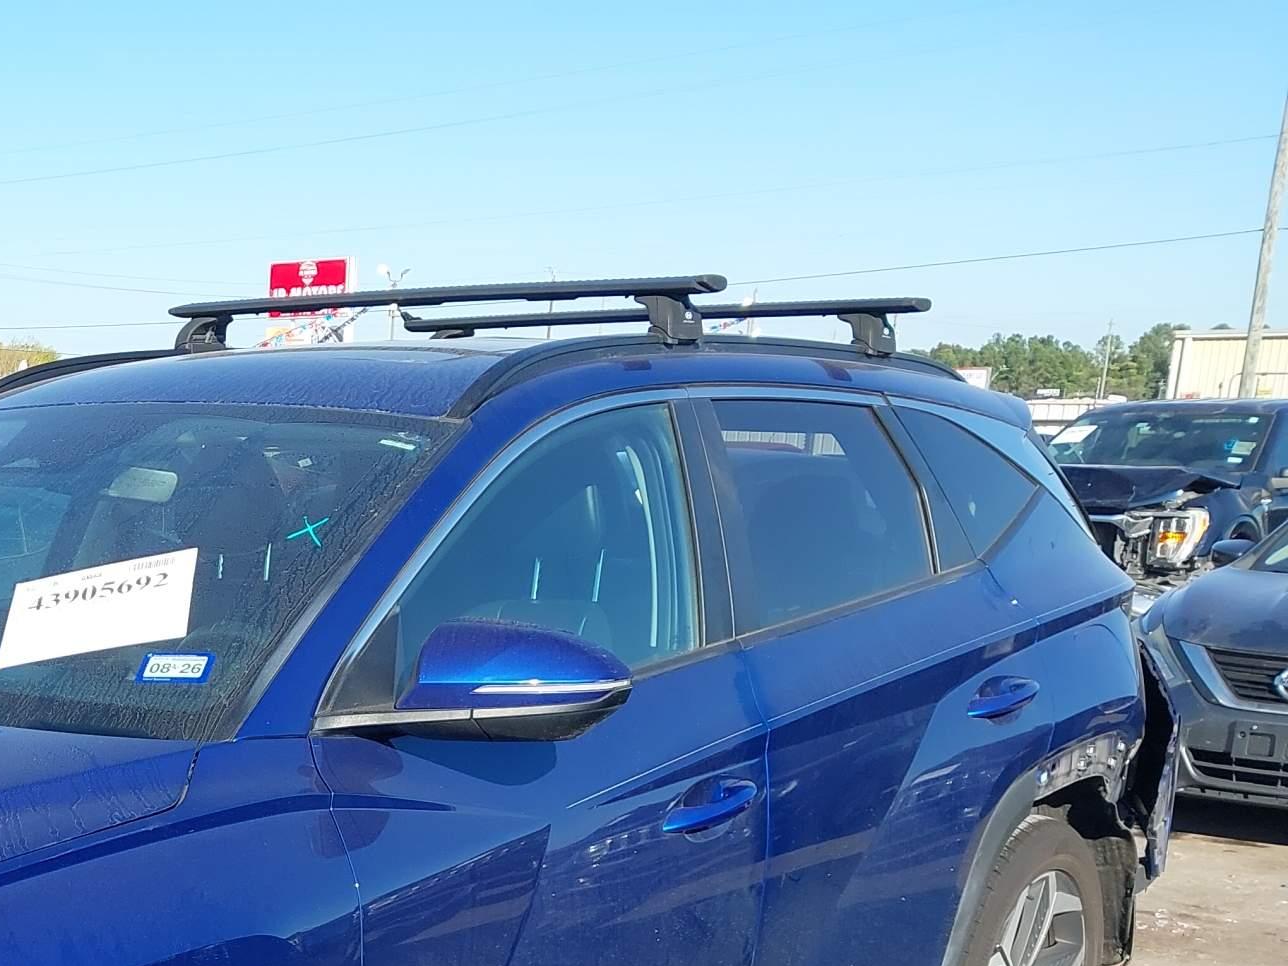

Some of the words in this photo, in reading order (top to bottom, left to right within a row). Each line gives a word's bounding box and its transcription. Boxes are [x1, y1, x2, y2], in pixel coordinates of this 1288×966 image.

[27, 572, 169, 611] 43905692
[149, 663, 171, 674] 08
[179, 663, 202, 674] 26
